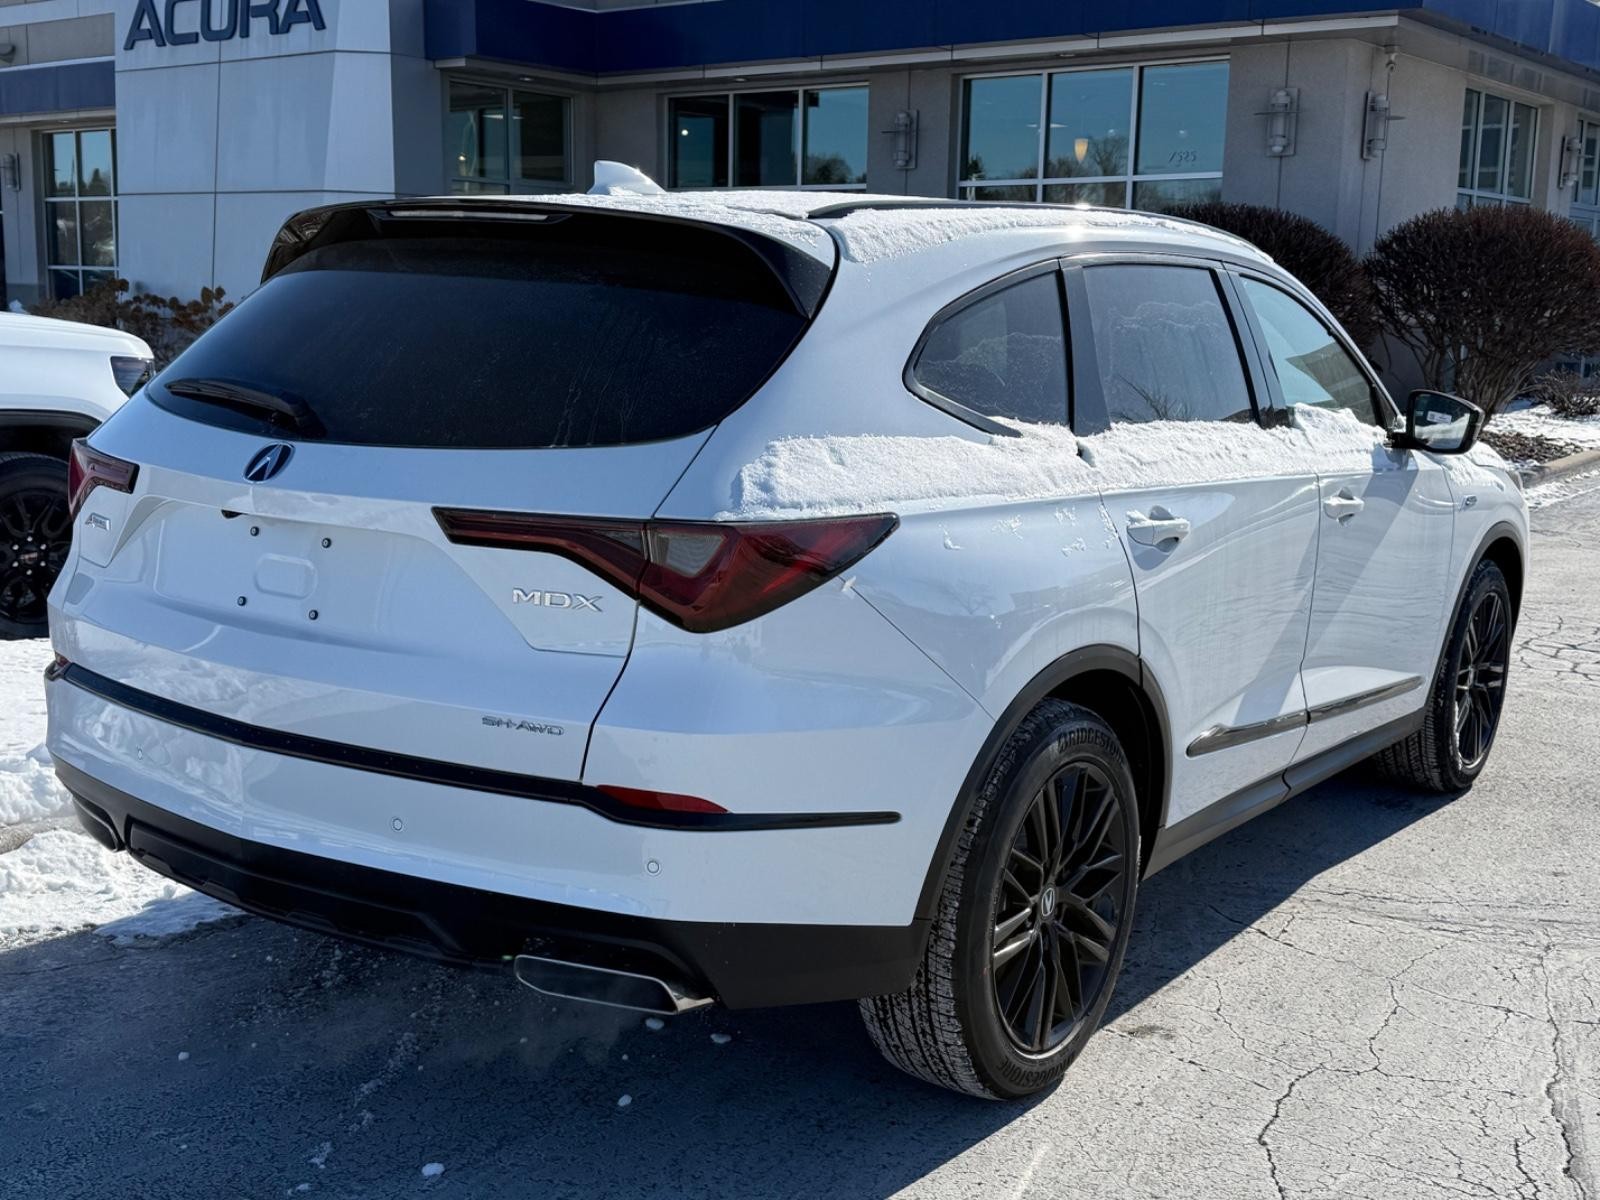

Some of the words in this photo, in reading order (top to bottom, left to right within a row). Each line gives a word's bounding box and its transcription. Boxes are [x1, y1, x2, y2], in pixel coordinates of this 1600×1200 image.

[123, 0, 326, 50] ACURA
[512, 587, 603, 612] MDX
[482, 715, 564, 736] SH-AWD
